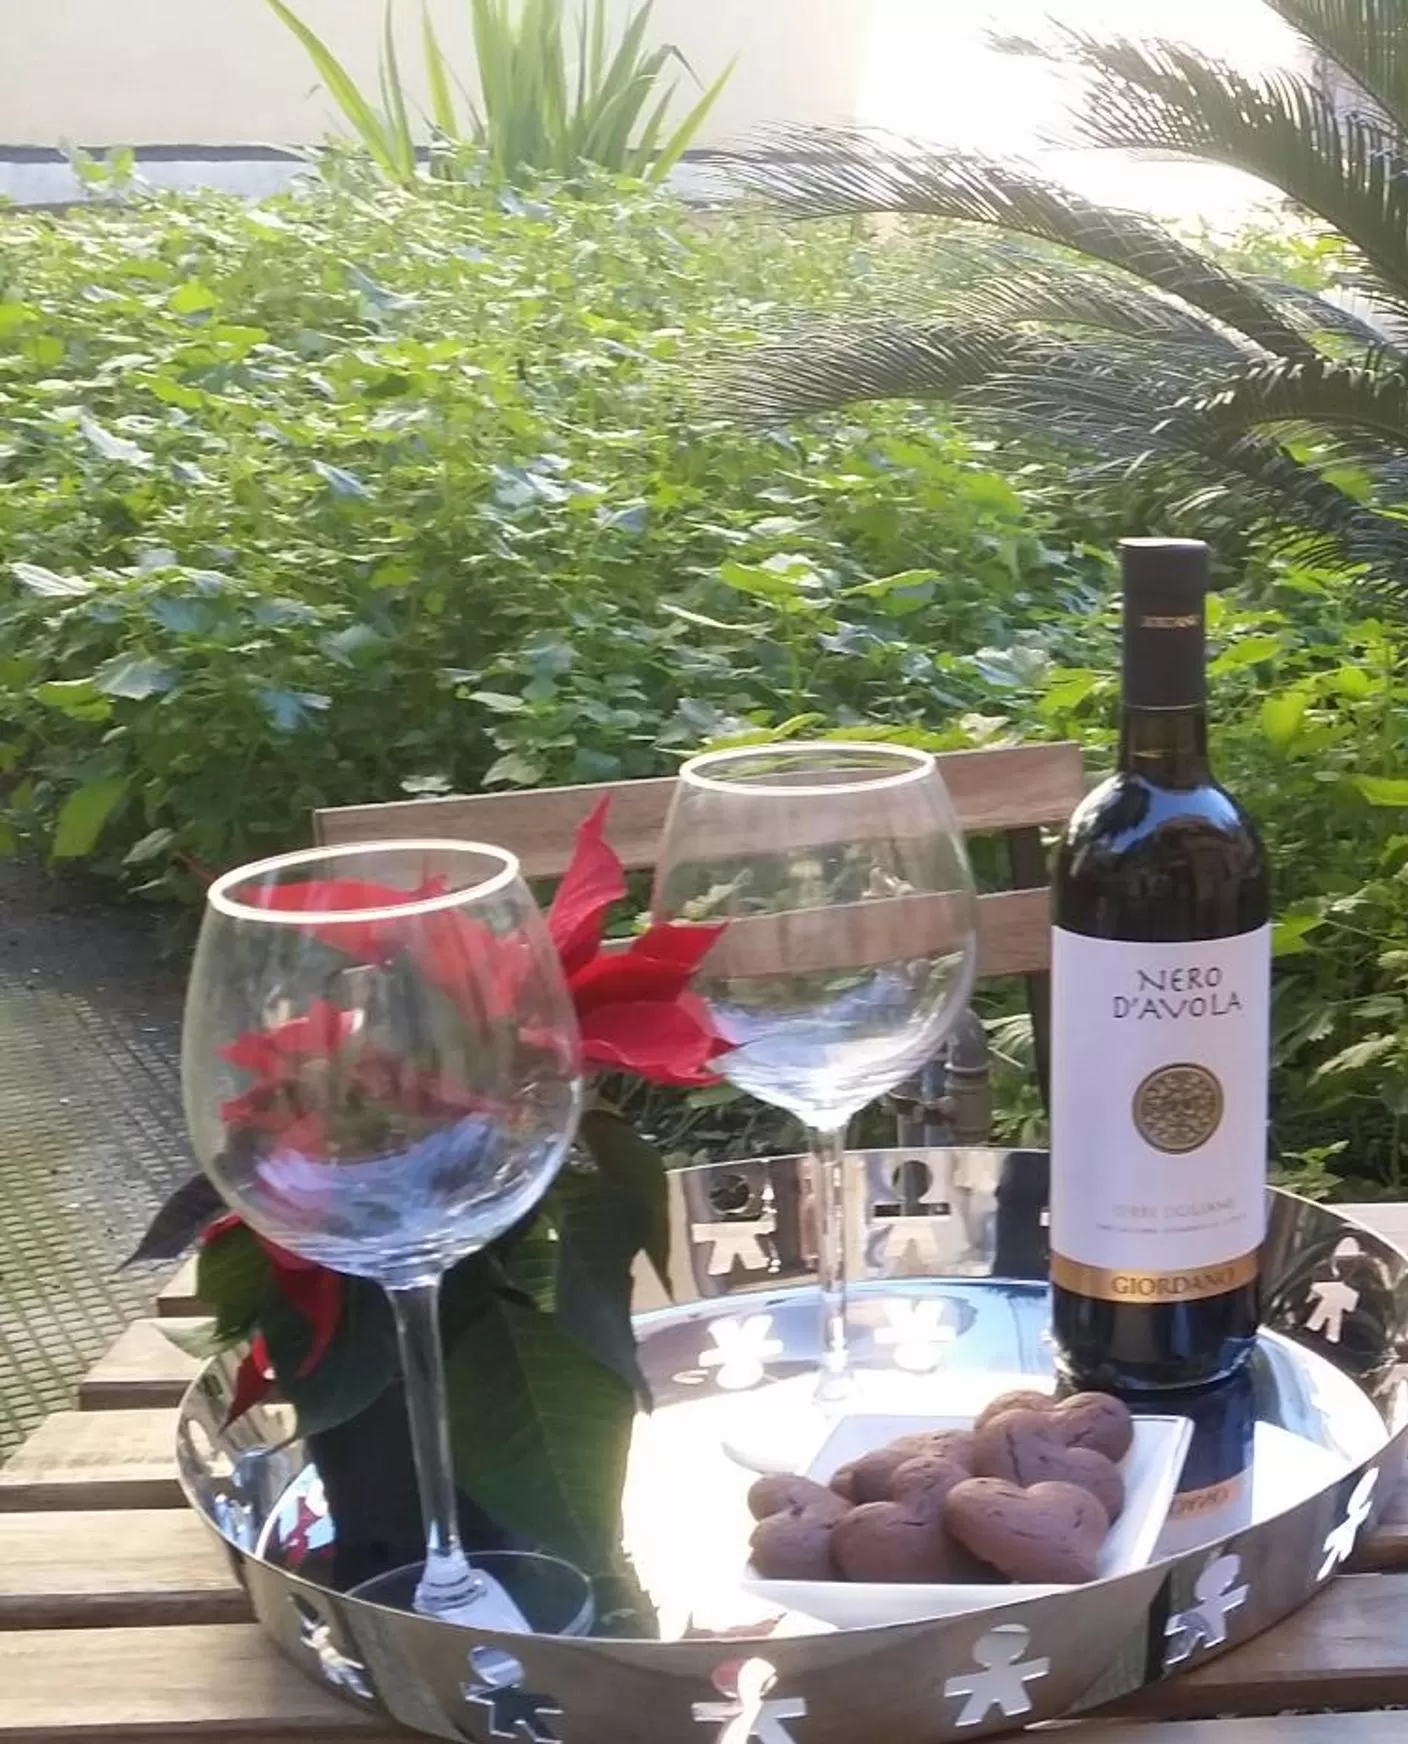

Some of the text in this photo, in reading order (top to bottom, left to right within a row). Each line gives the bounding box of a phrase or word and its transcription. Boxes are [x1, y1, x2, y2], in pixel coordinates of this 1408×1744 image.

[1137, 966, 1224, 992] NERO
[1112, 991, 1243, 1020] D'AVOLA
[1111, 1266, 1235, 1296] GIORDANO
